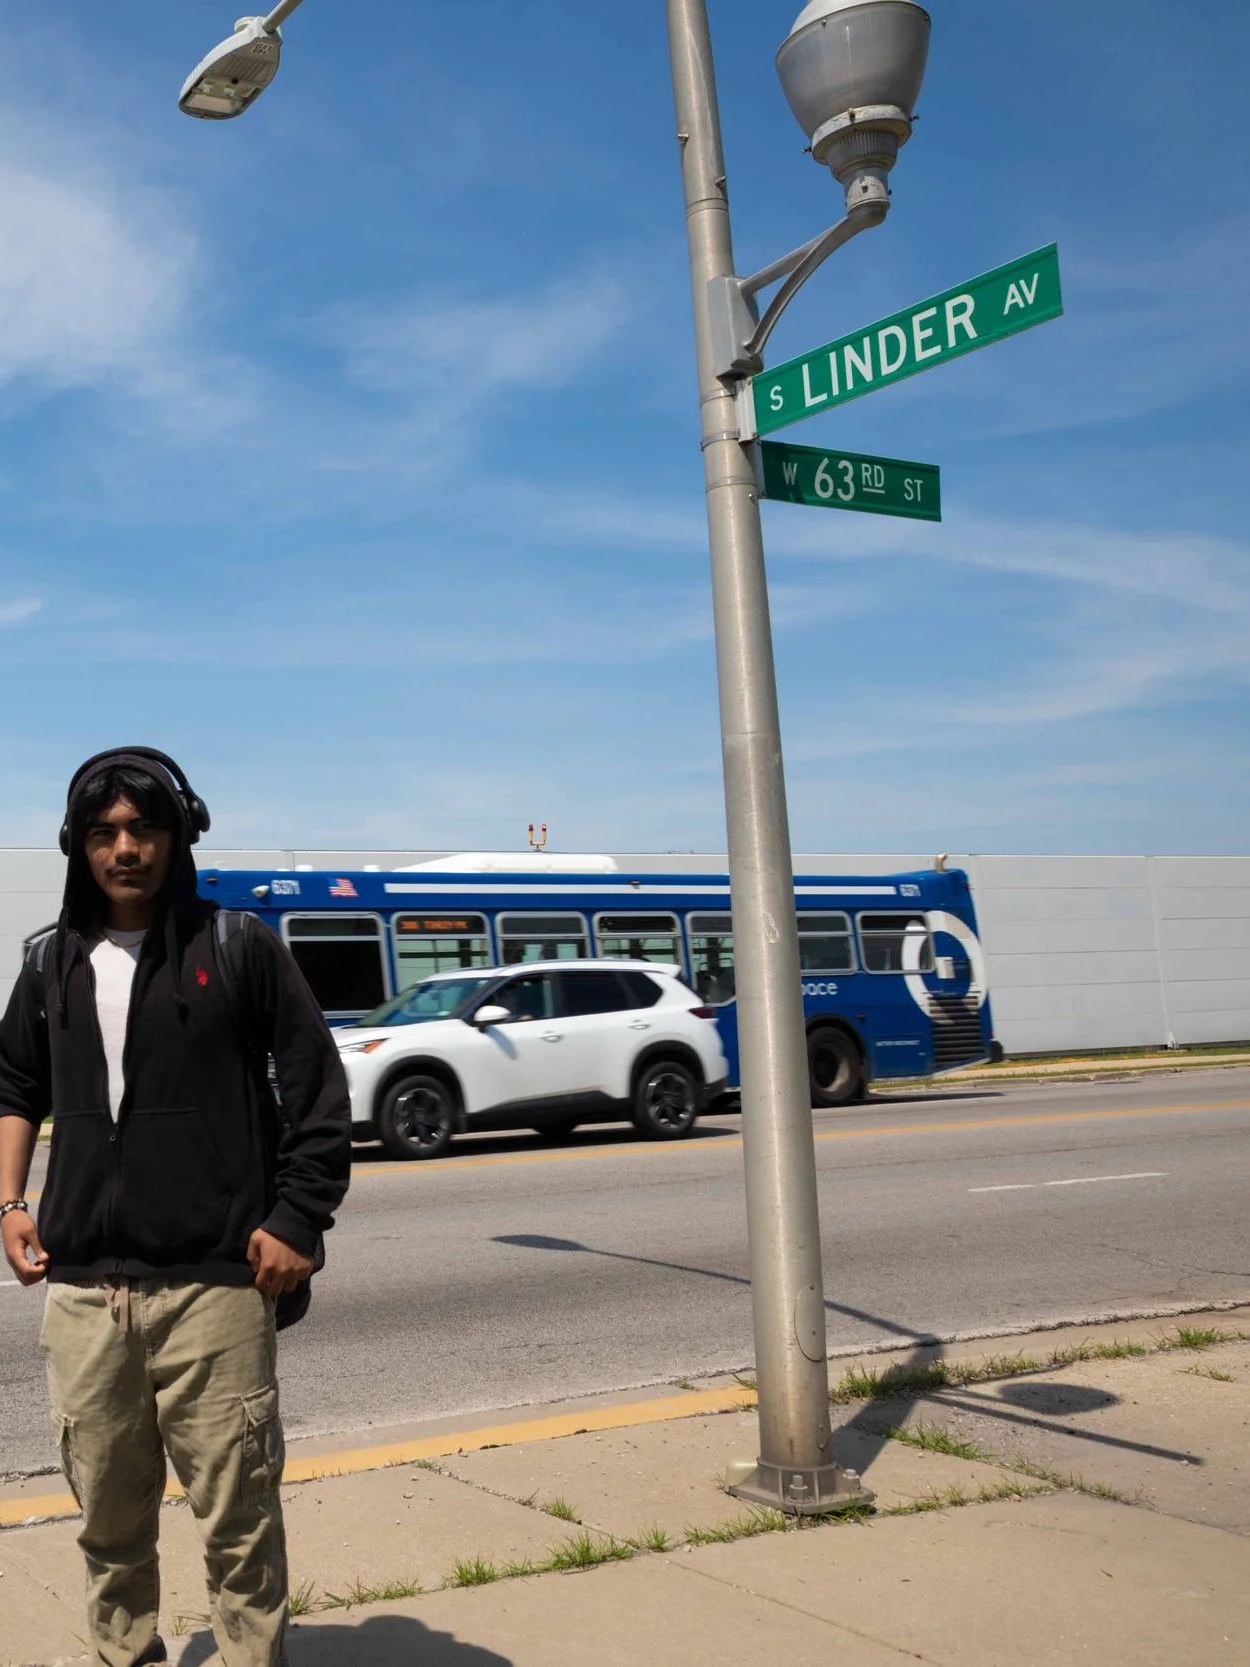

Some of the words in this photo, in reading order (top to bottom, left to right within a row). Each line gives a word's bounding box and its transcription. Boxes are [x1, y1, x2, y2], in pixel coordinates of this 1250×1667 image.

[770, 385, 783, 411] S
[801, 294, 978, 408] LINDER
[1003, 273, 1039, 316] AV
[783, 462, 797, 486] W
[903, 478, 924, 502] ST
